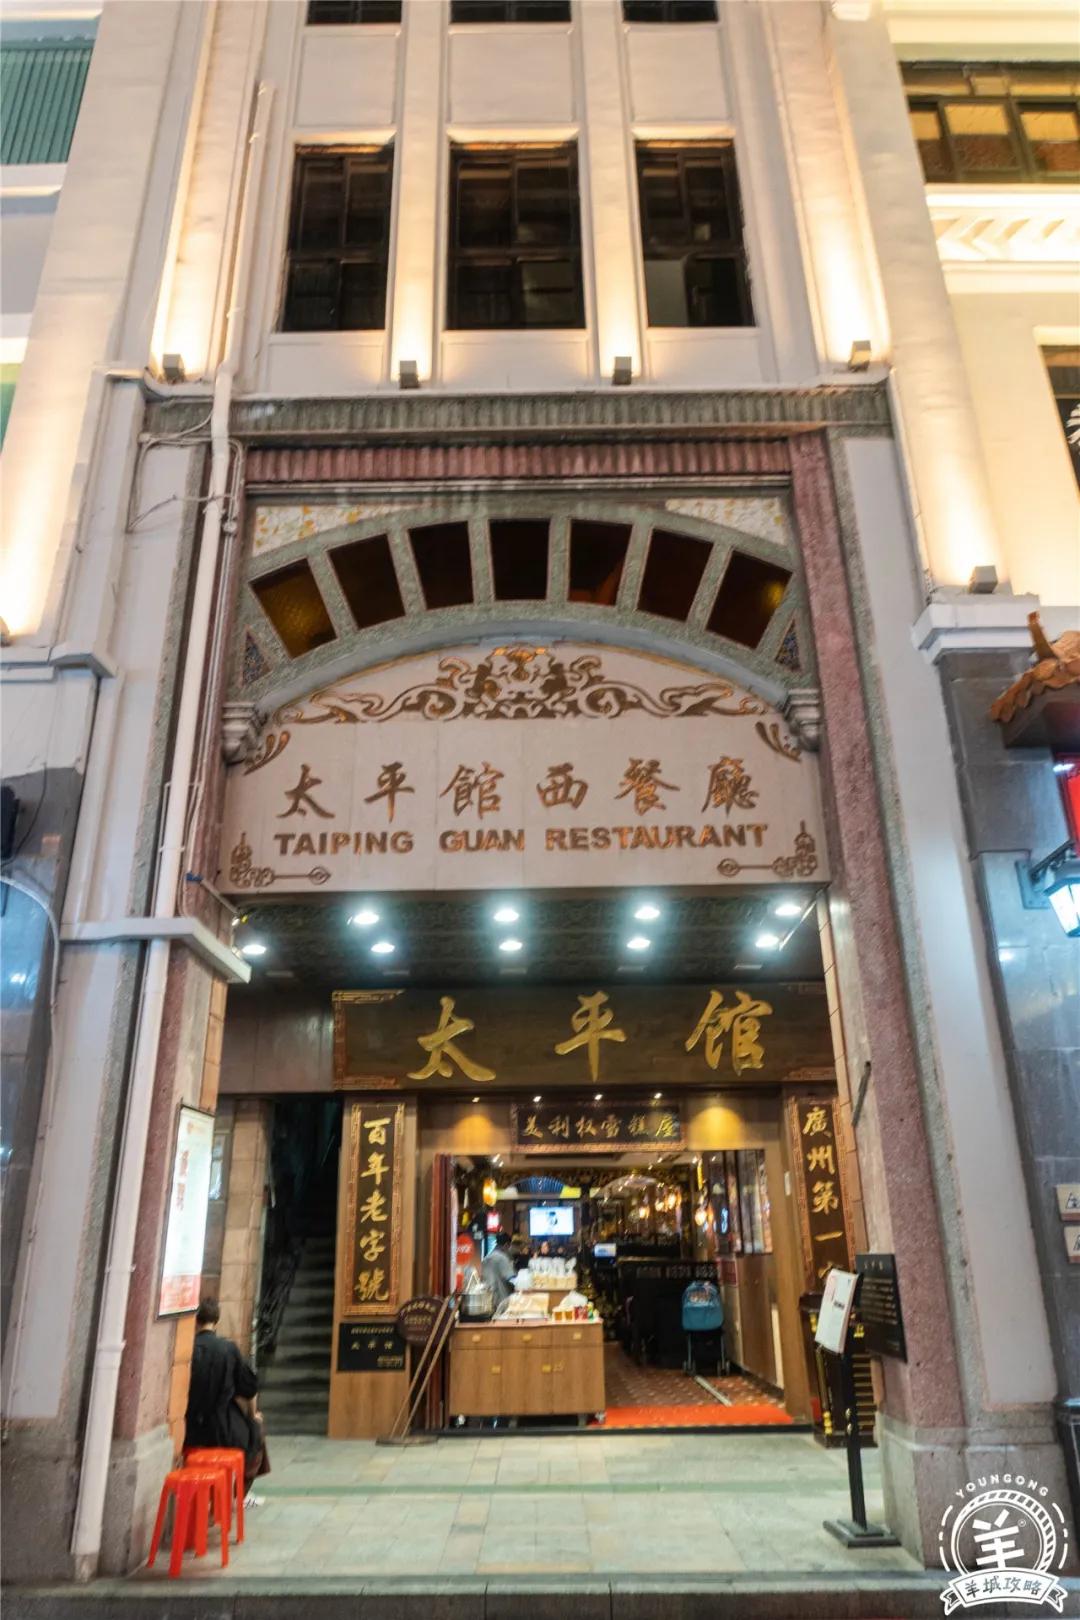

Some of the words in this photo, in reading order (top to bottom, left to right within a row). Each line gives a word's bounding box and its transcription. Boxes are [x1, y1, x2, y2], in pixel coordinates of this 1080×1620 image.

[273, 830, 413, 856] TAIPING
[439, 826, 525, 853] GUAN
[545, 823, 769, 852] RESTAURANT
[276, 757, 761, 820] 太平館西餐廳
[357, 1117, 391, 1301] 百年老字號
[803, 1106, 843, 1278] 廣州第一
